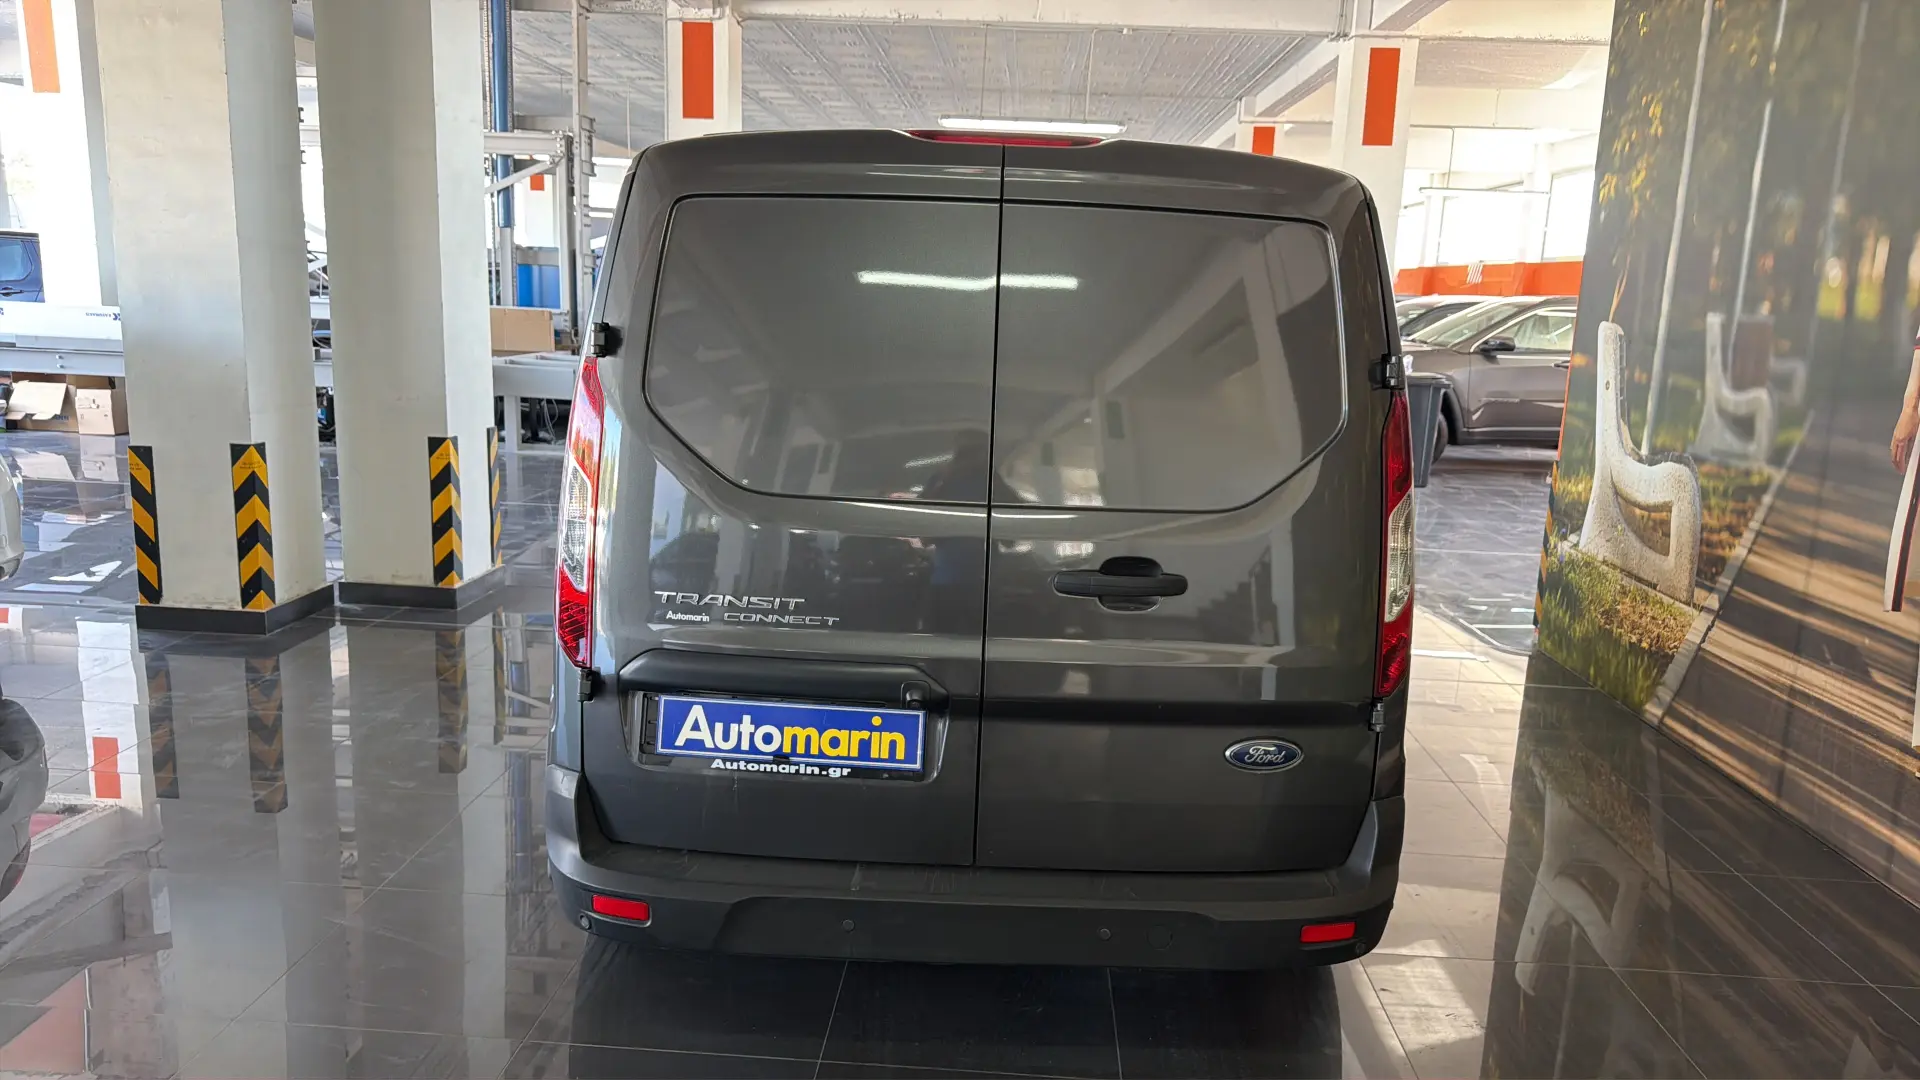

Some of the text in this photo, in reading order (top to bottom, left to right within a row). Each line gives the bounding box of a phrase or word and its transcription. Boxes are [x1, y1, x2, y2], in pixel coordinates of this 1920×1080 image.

[654, 590, 806, 611] TRANSIT
[666, 610, 710, 623] Automarin
[723, 612, 840, 626] CONNECT
[674, 704, 906, 760] Automarin
[1244, 745, 1286, 764] Ford
[710, 758, 852, 778] Automarin.gr
